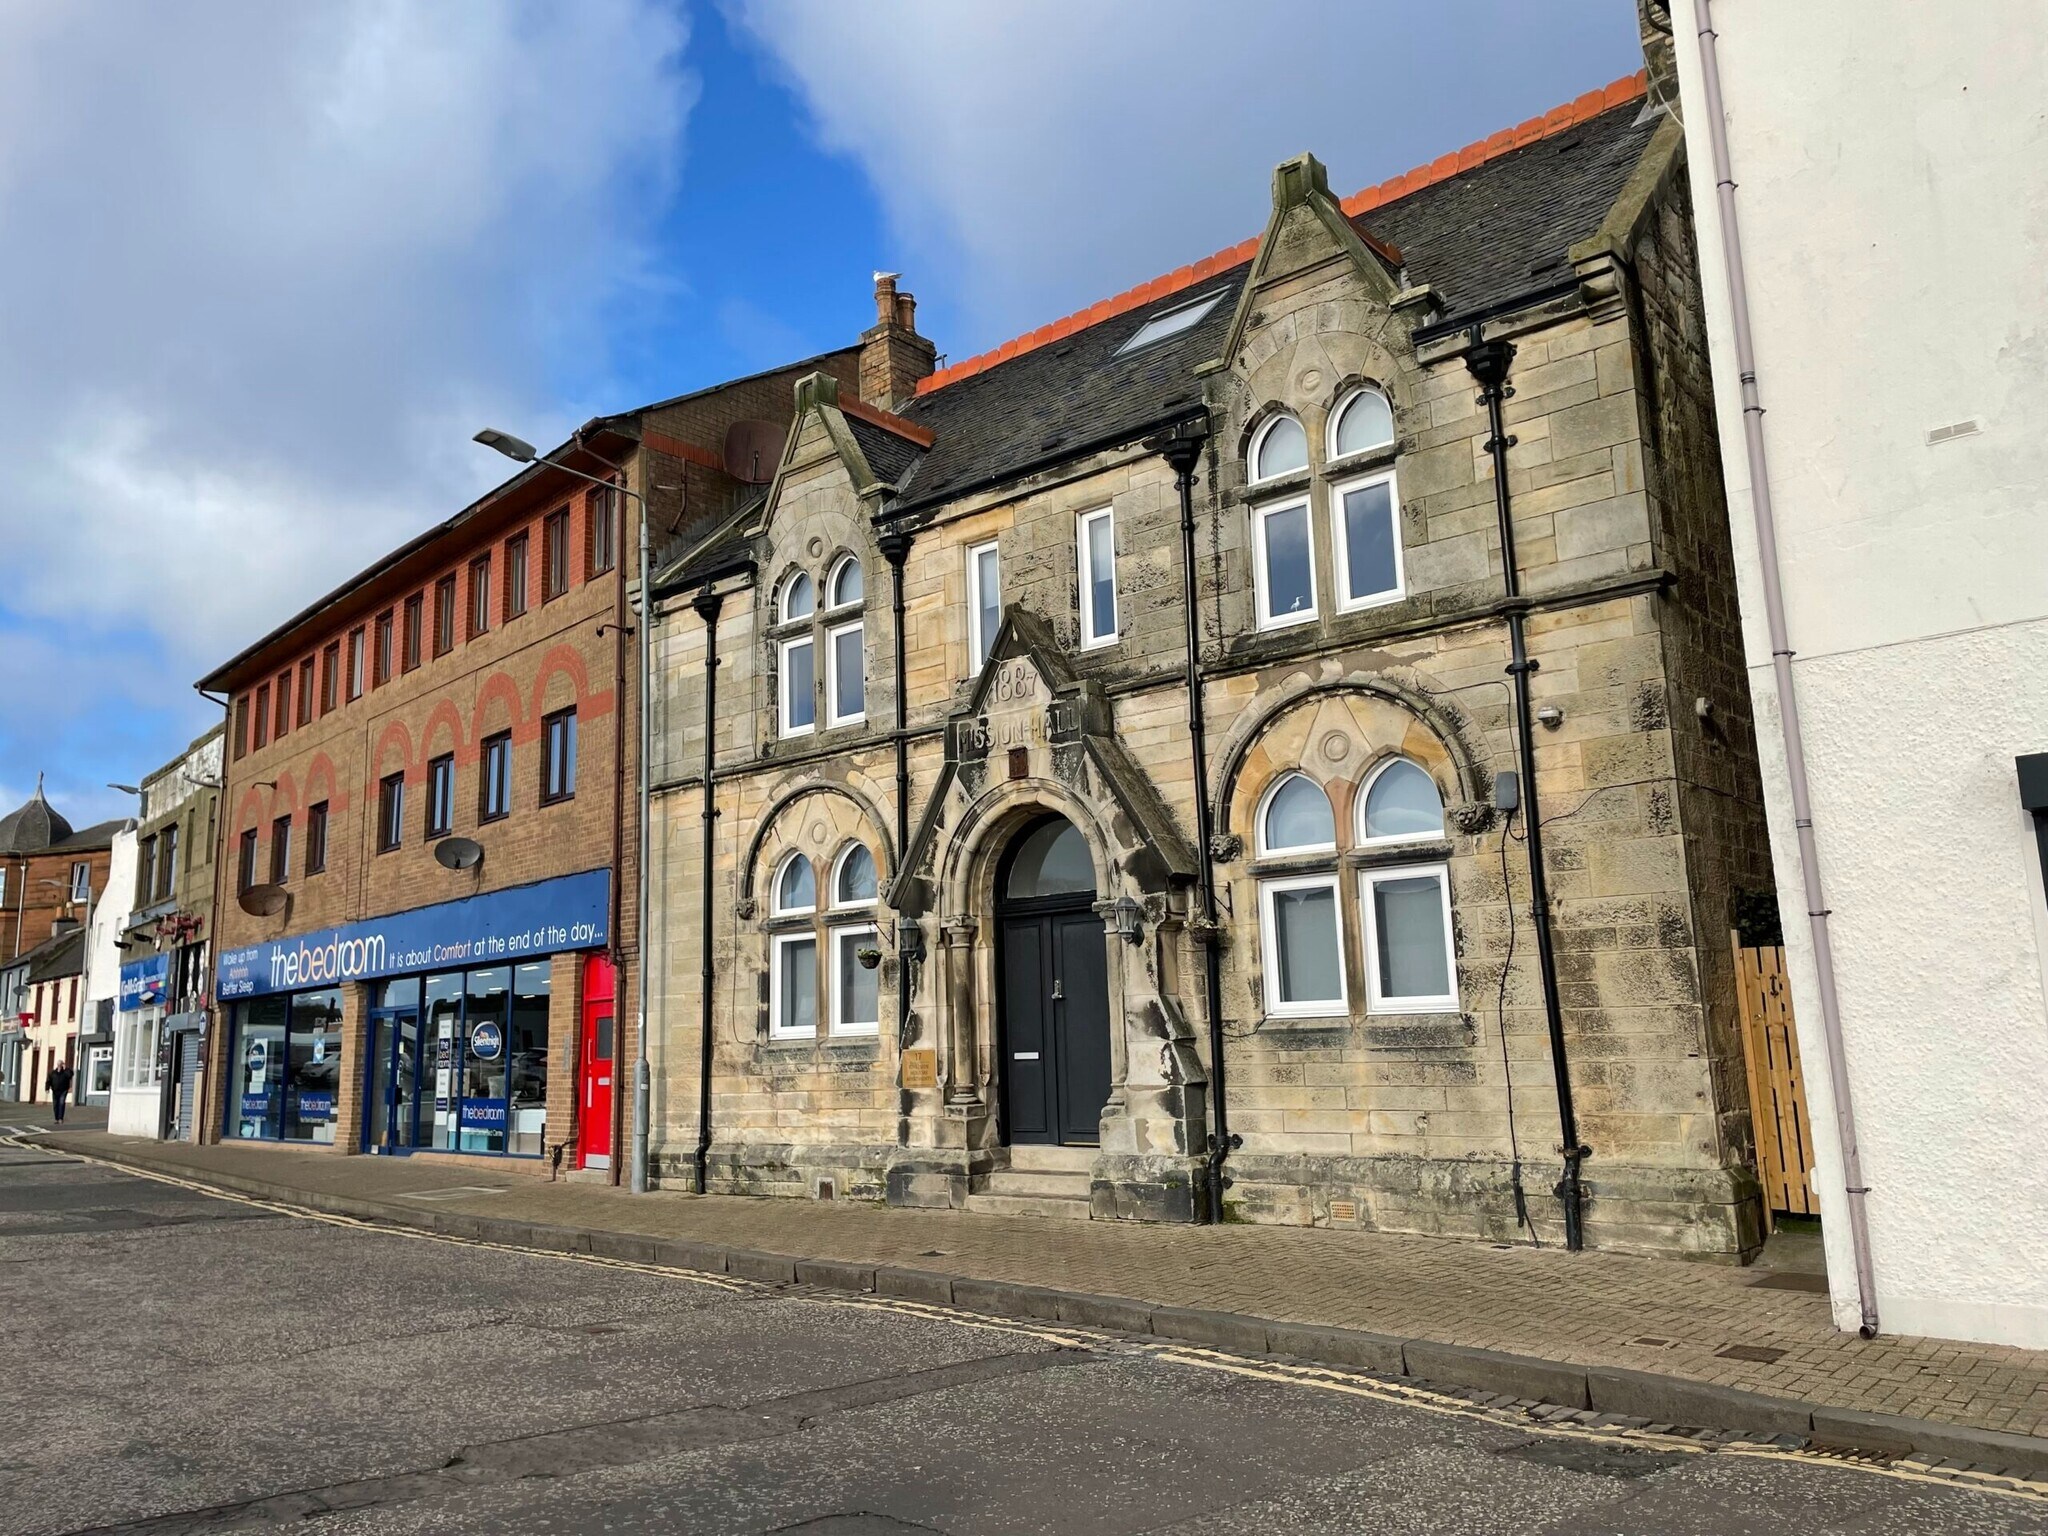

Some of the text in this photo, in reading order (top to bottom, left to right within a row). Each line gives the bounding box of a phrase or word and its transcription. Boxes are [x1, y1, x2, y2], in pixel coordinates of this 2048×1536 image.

[994, 665, 1039, 704] 1887
[238, 952, 245, 964] up
[389, 953, 395, 969] It
[397, 951, 403, 967] is
[406, 946, 432, 966] about
[434, 940, 472, 962] Comfort
[474, 937, 485, 956] at
[488, 935, 505, 953] the
[509, 930, 530, 950] end
[534, 926, 545, 947] of
[547, 925, 566, 945] the
[271, 933, 385, 988] thebedroom
[222, 982, 238, 995] Better
[915, 1053, 922, 1061] 17
